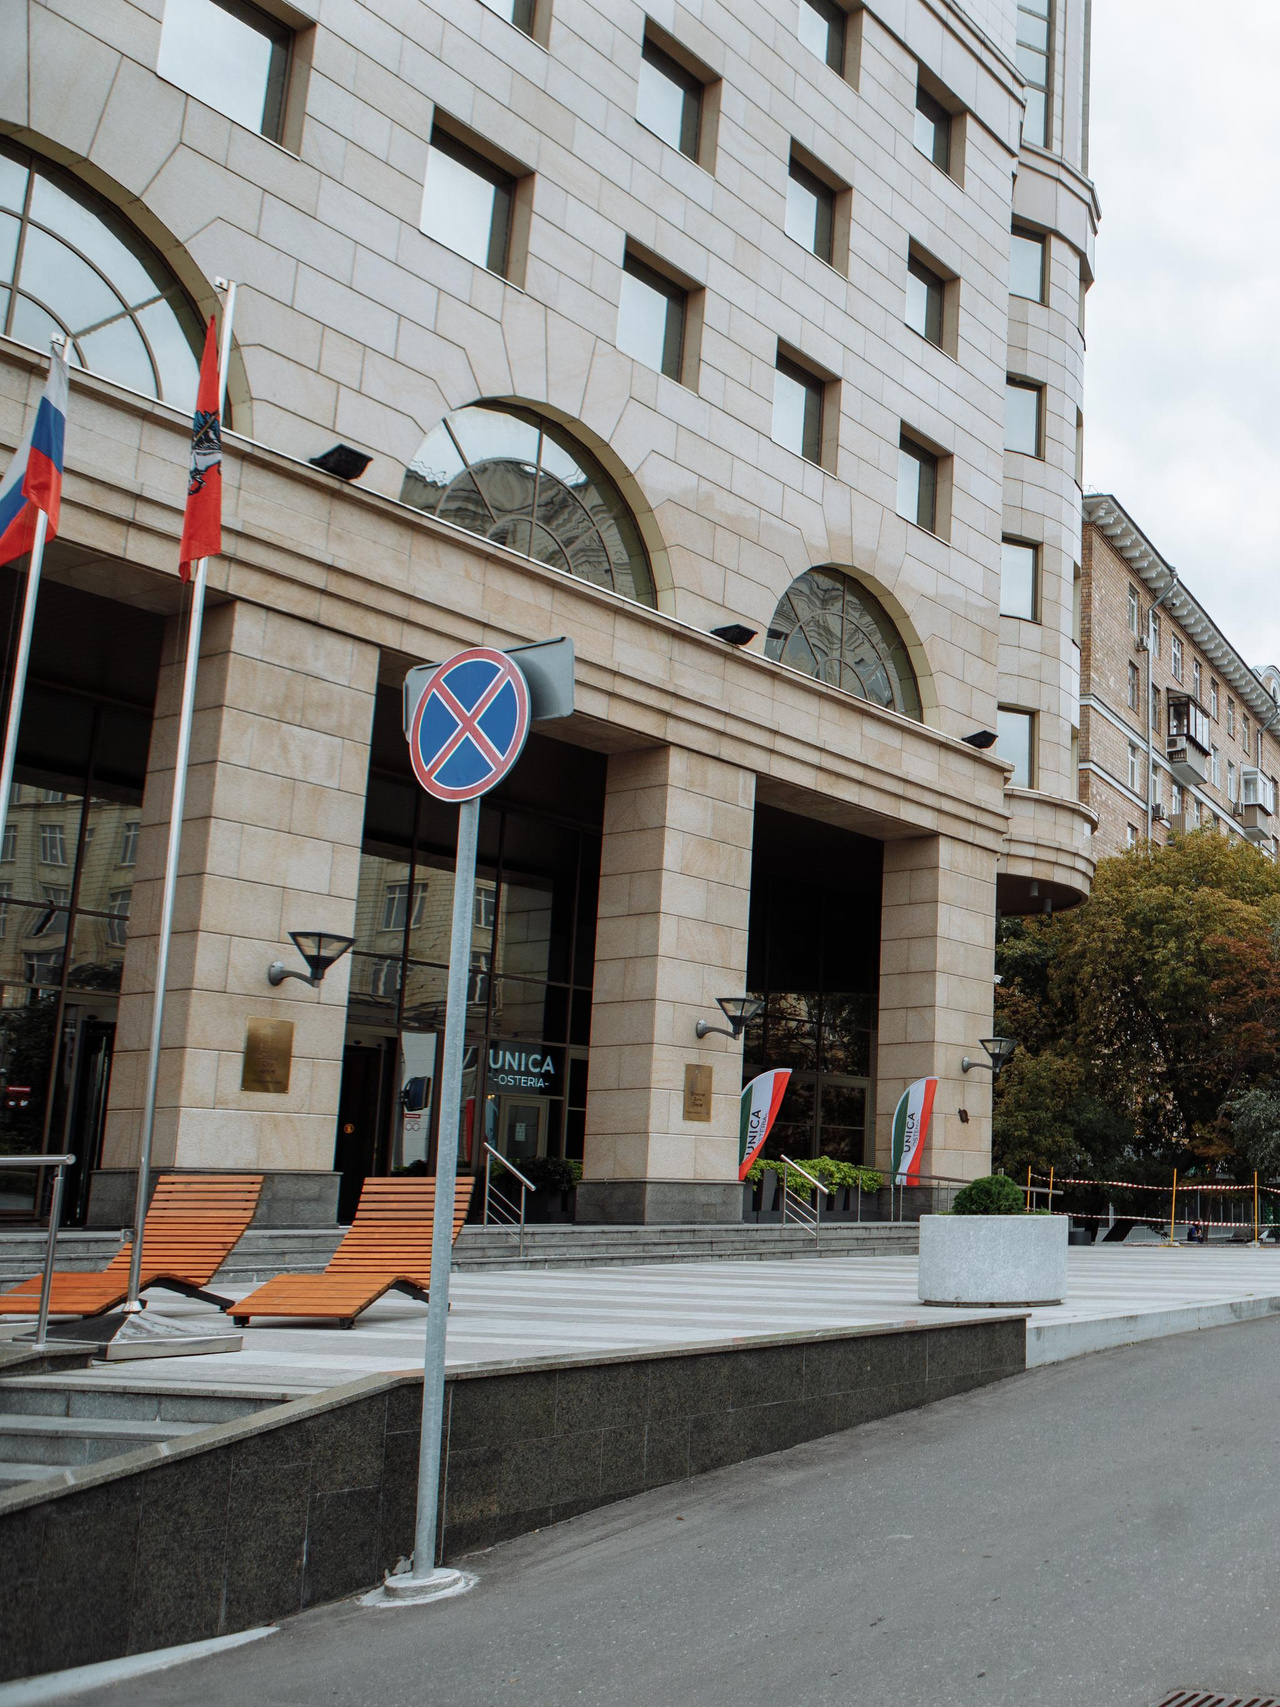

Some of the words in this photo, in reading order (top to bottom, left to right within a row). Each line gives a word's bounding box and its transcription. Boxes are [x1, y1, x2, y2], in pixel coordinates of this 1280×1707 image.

[489, 1049, 555, 1074] UNICA
[746, 1109, 762, 1156] UNICA
[903, 1112, 916, 1153] UNICA
